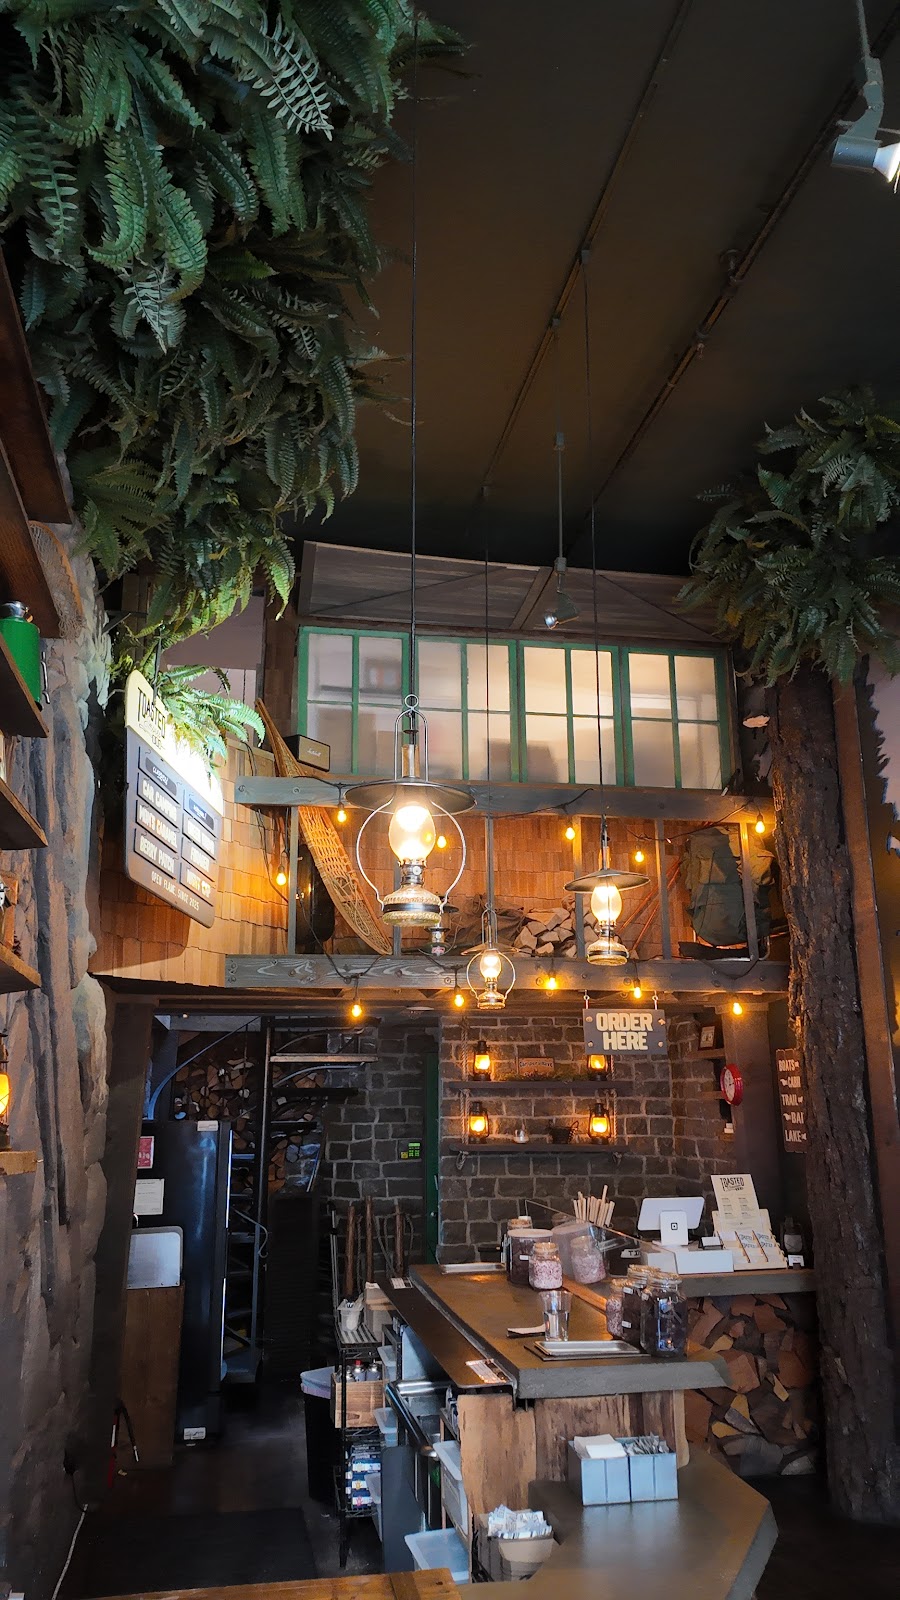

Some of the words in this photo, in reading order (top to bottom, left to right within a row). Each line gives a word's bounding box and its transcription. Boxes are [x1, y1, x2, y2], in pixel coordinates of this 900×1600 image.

[138, 687, 166, 738] TOASTED
[140, 835, 158, 861] BERRY
[596, 1012, 653, 1032] ORDER
[602, 1031, 649, 1051] HERE
[778, 1059, 796, 1072] BOATS
[781, 1093, 799, 1106] TRAIL
[784, 1129, 802, 1143] LAKE
[720, 1177, 745, 1192] TOASTED
